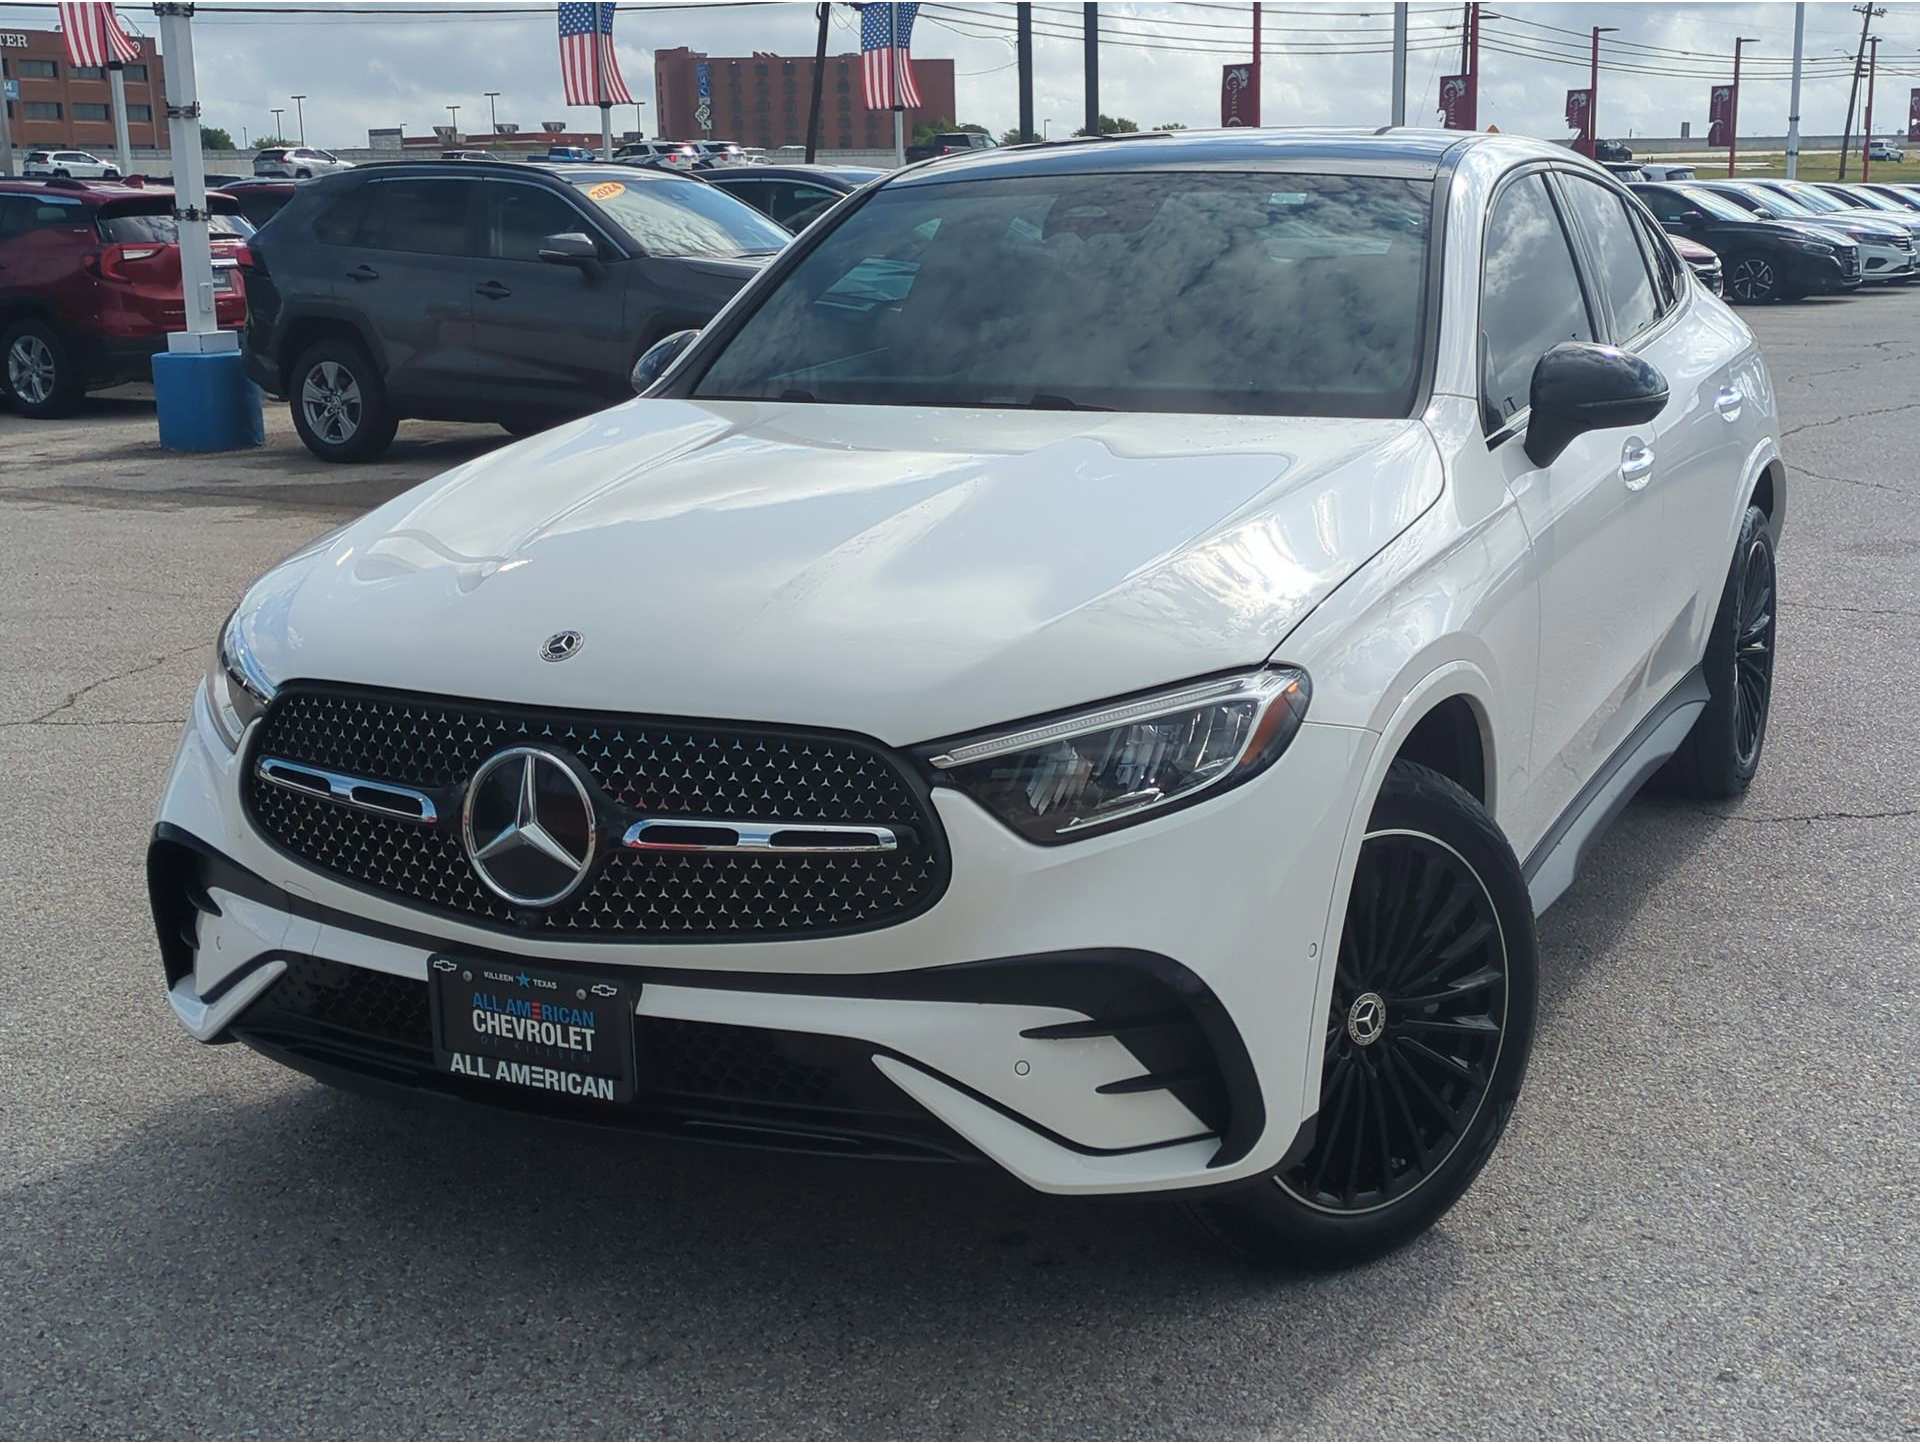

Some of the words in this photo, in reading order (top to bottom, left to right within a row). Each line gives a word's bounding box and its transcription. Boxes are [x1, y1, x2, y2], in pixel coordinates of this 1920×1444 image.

[591, 183, 622, 198] 2024
[484, 971, 514, 983] KILLEEN
[533, 979, 558, 990] TEXAS
[472, 992, 502, 1013] ALL
[506, 1000, 595, 1027] AMERICAN
[472, 1009, 596, 1052] CHEVROLET
[450, 1052, 491, 1079] ALL
[495, 1060, 614, 1101] AMERICAN
